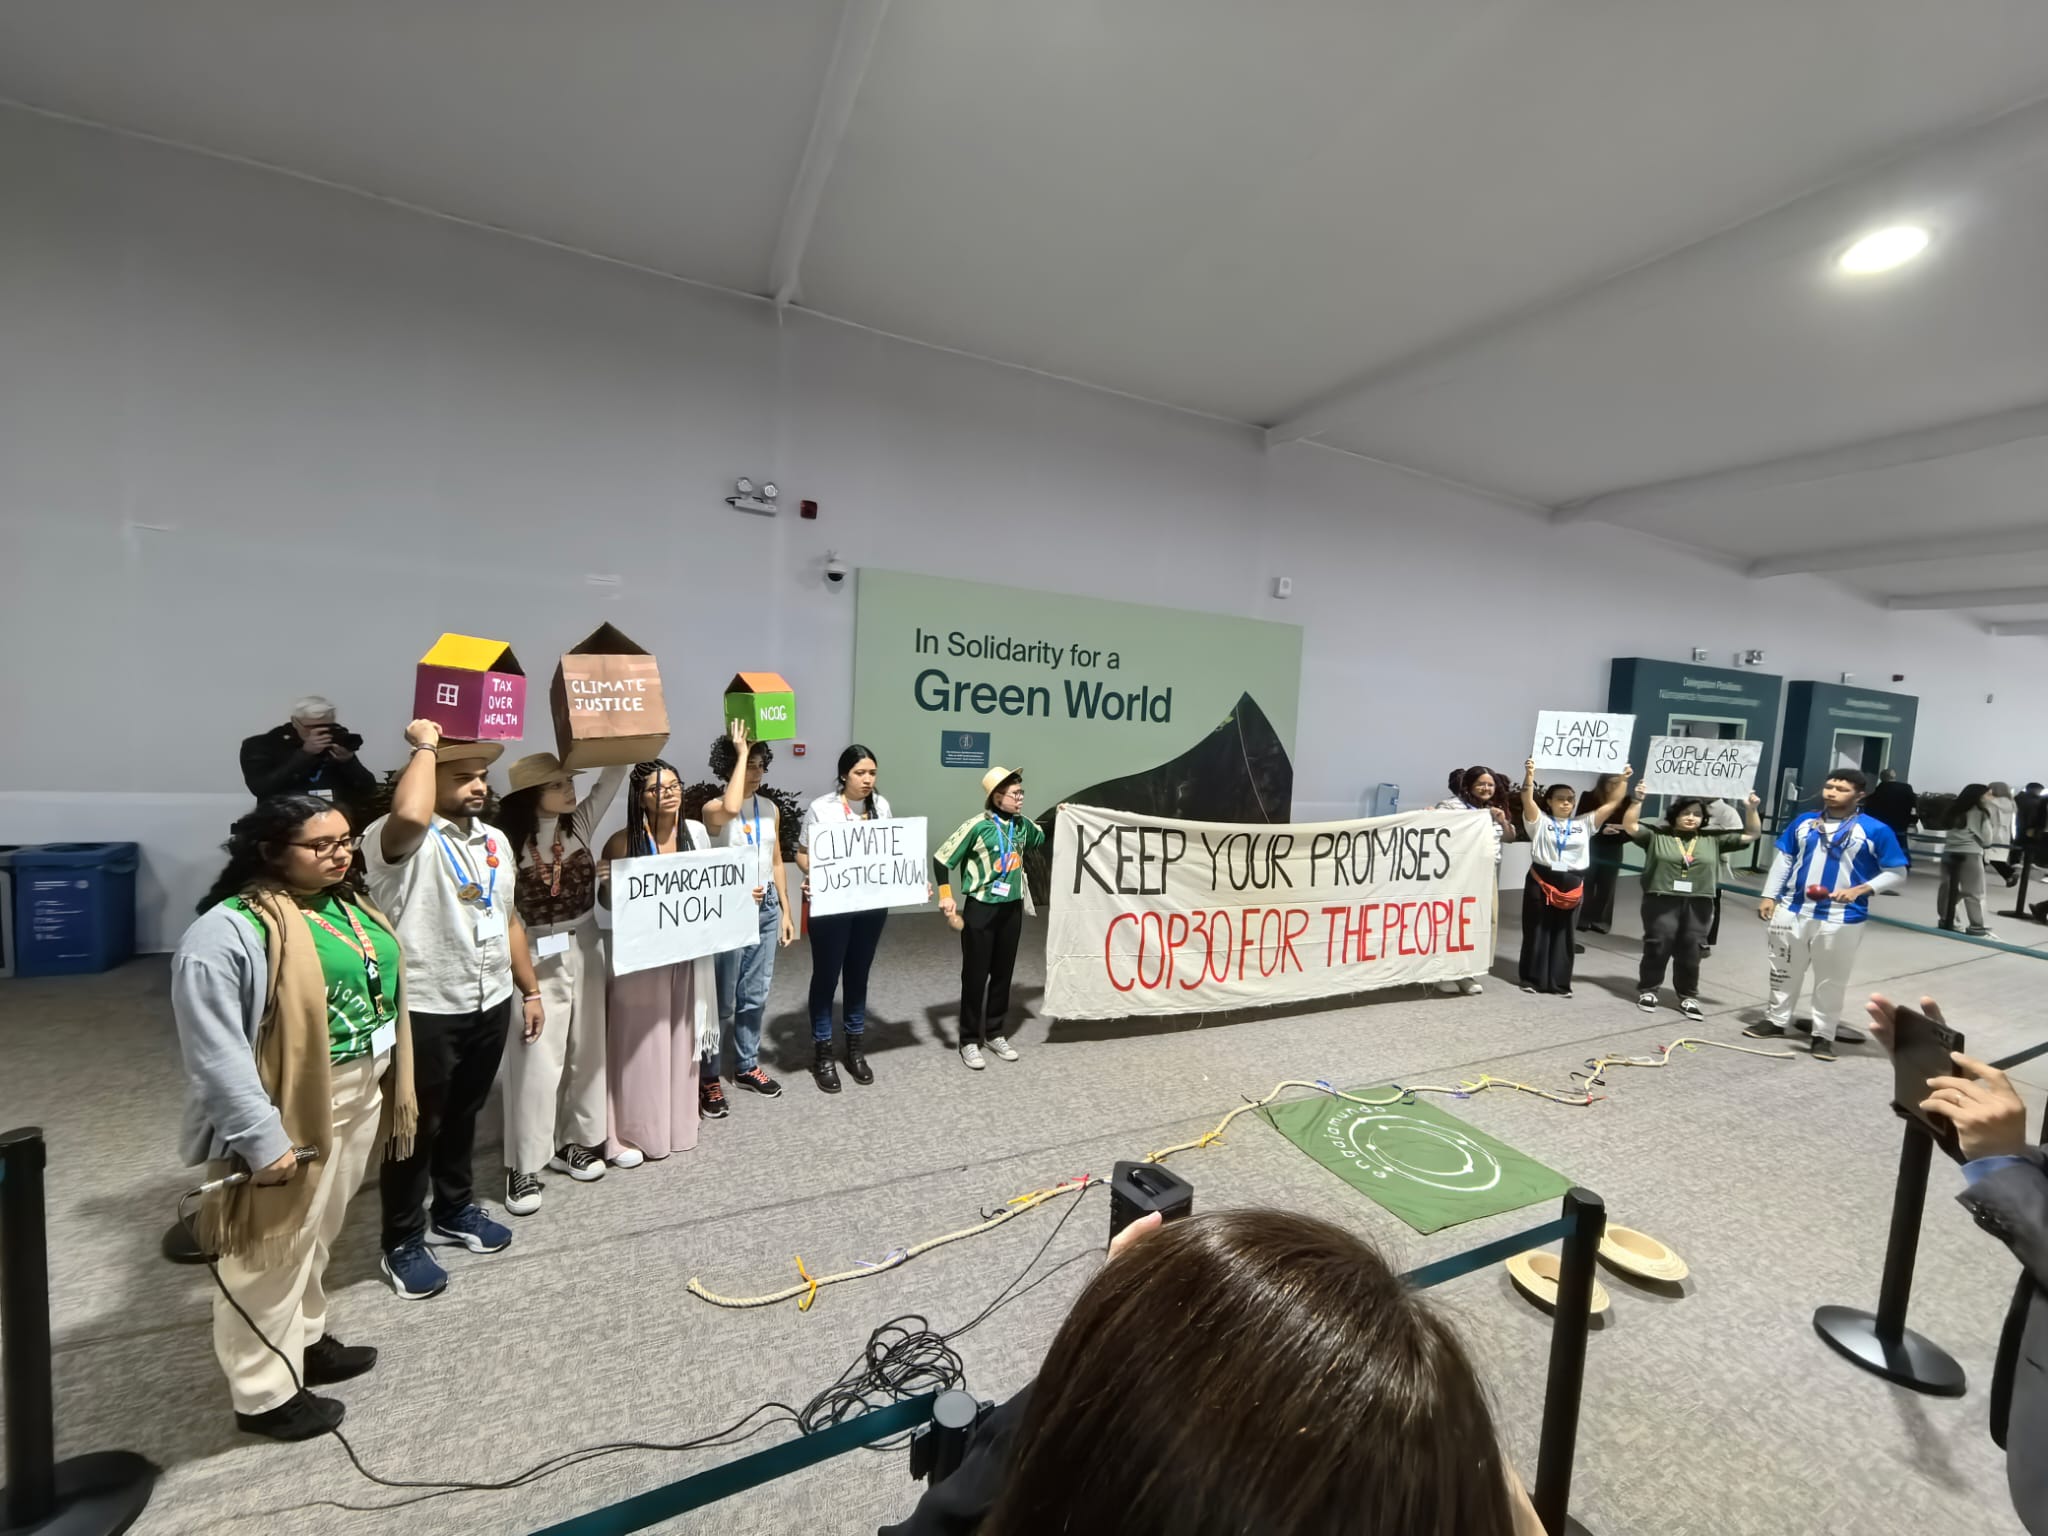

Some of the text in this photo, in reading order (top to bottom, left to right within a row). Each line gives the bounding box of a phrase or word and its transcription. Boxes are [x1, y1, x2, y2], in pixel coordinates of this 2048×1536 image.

[915, 628, 1120, 670] In Solidarity for a
[492, 678, 513, 692] TAX
[571, 678, 646, 694] CLIMATE
[914, 668, 1172, 723] Green World
[488, 695, 513, 710] OVER
[574, 697, 645, 711] JUSTICE
[484, 713, 518, 726] WEALTH
[1555, 719, 1609, 738] LAND
[1541, 736, 1620, 760] RIGHTS
[1662, 745, 1740, 763] POPULAR
[1654, 759, 1748, 780] SOVEREIGNTY
[813, 825, 904, 862] CLIMATE
[1073, 823, 1451, 896] KEEP YOUR PROMISES
[628, 863, 745, 900] DEMARCATION
[813, 858, 926, 894] JUSTICE NOW
[658, 894, 723, 930] NOW
